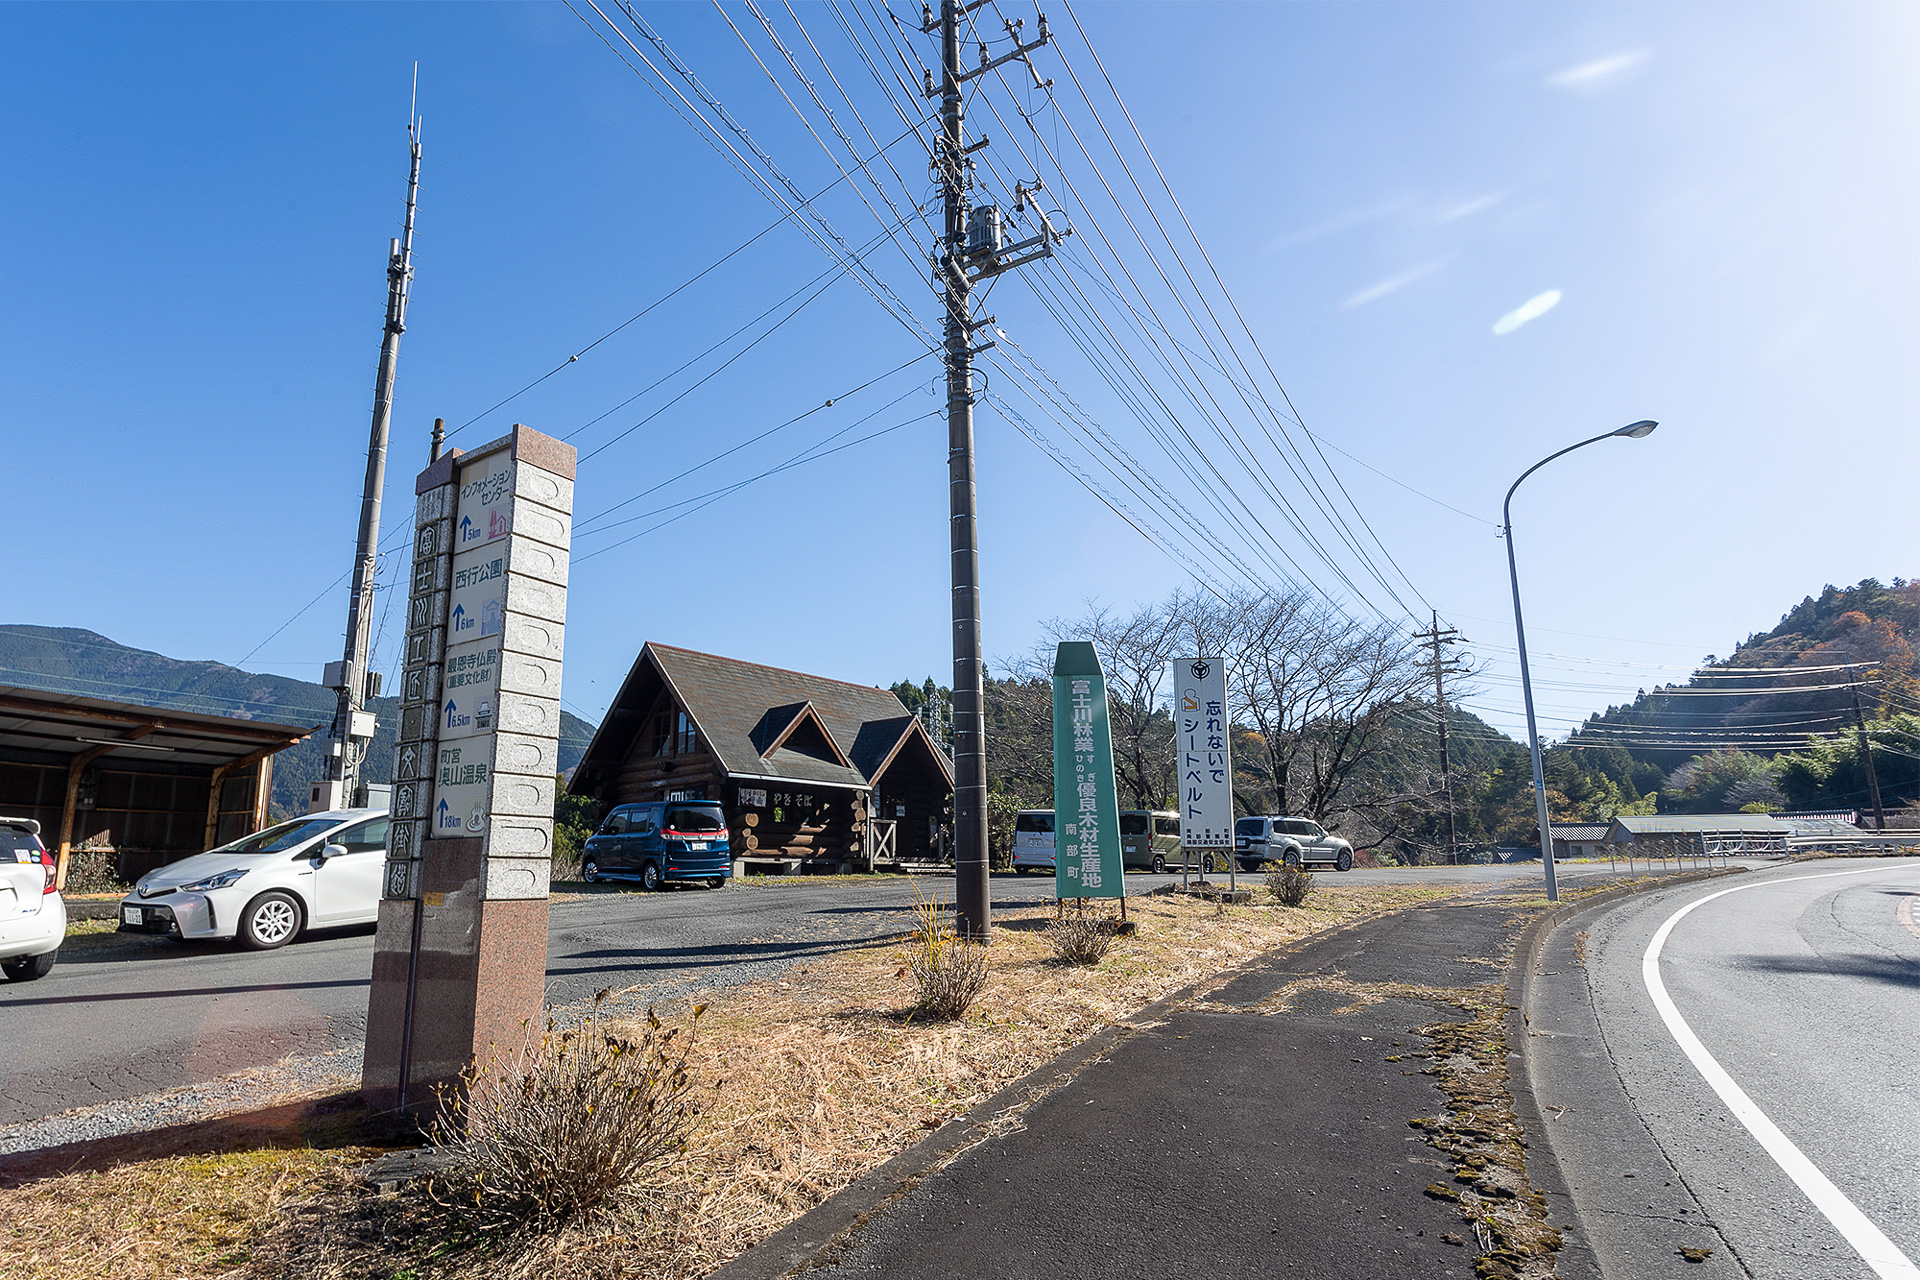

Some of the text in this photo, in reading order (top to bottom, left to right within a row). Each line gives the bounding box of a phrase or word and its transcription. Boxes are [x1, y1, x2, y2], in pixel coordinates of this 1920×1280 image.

[461, 469, 511, 500] インフォメーション
[481, 487, 510, 506] センター
[467, 527, 481, 541] 5km
[455, 558, 503, 590] 西行公園
[461, 617, 475, 631] 6km
[447, 649, 497, 674] 最恩寺仏殿
[451, 714, 471, 728] 6.5km
[1071, 679, 1094, 752] 富士川林業
[1205, 700, 1225, 785] 忘れないで
[441, 748, 461, 764] 町営
[438, 765, 487, 789] 奥山温泉
[1184, 718, 1203, 820] シートベルト
[773, 792, 813, 807] やきそば
[444, 816, 461, 829] 18km
[1076, 782, 1102, 888] 優良木材生産地
[1065, 823, 1080, 879] 南部町
